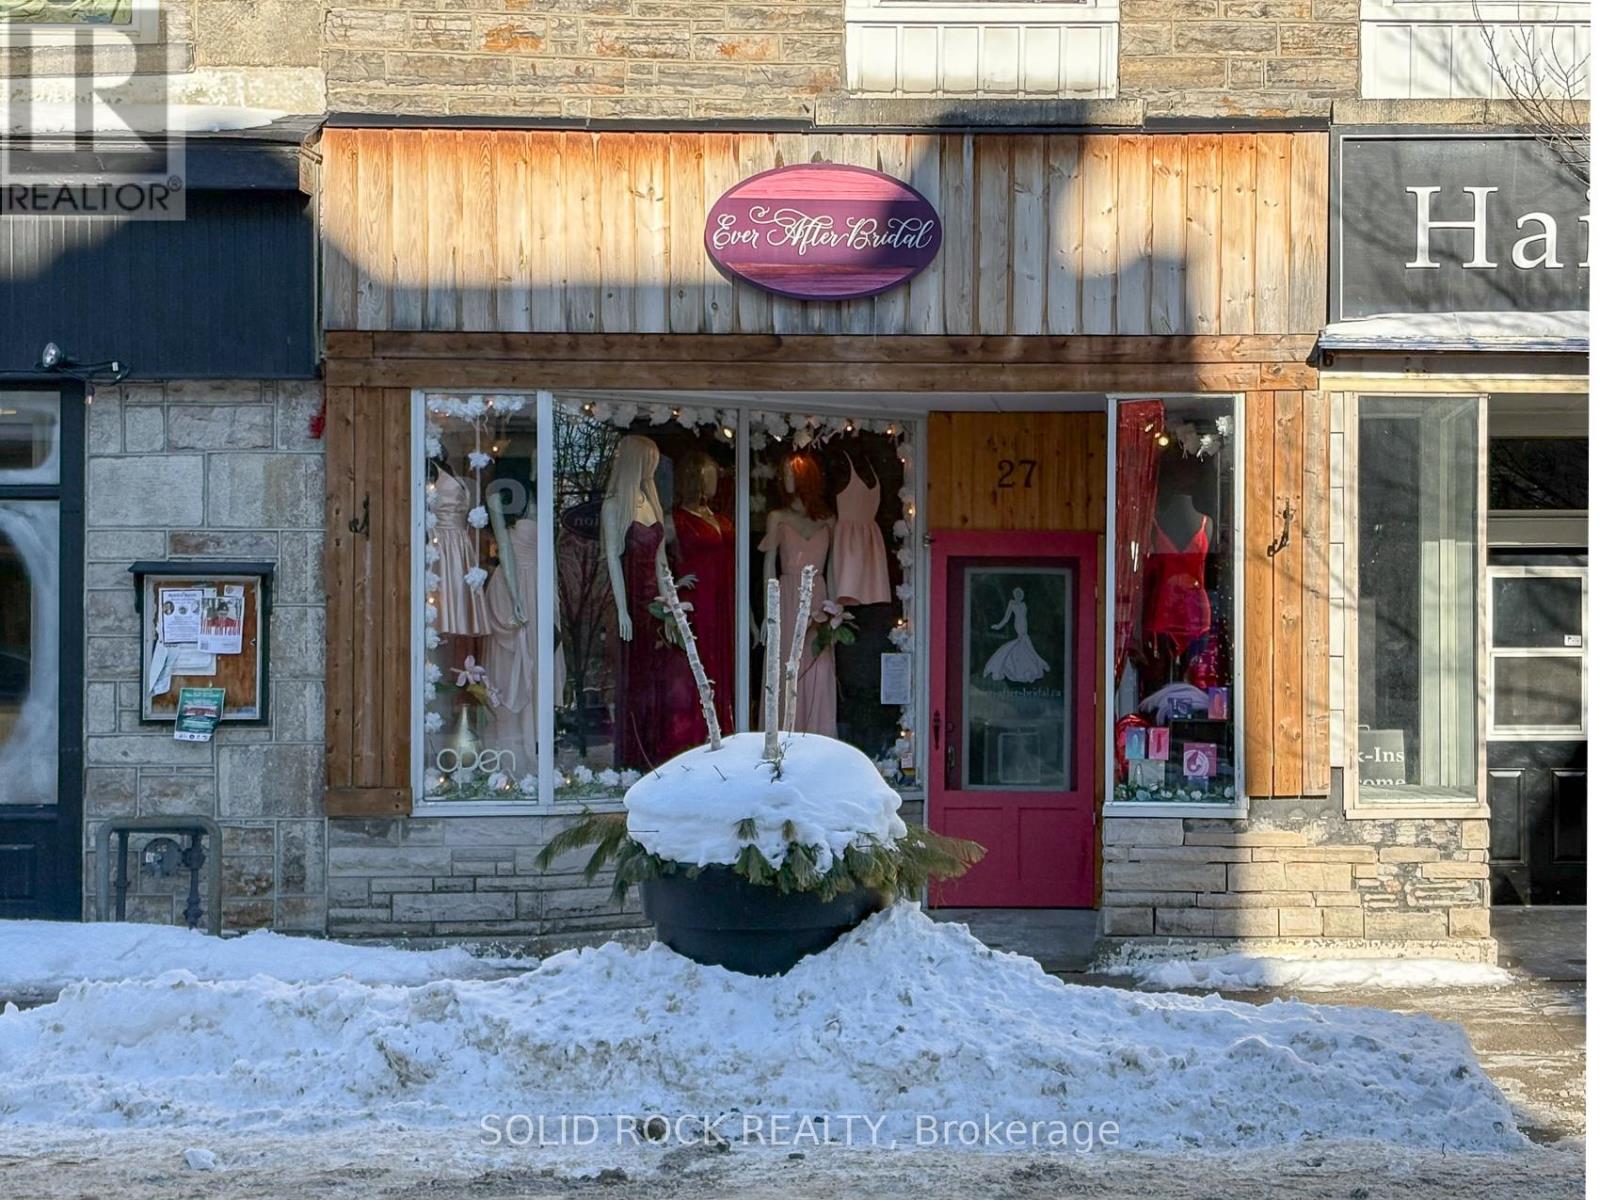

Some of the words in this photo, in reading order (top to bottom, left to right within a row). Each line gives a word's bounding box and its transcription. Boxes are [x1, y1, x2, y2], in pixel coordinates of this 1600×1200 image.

[712, 213, 760, 250] Ever
[749, 205, 849, 256] After
[846, 216, 936, 250] Bridal
[997, 459, 1038, 489] 27
[436, 747, 517, 790] open
[1358, 777, 1406, 786] ome
